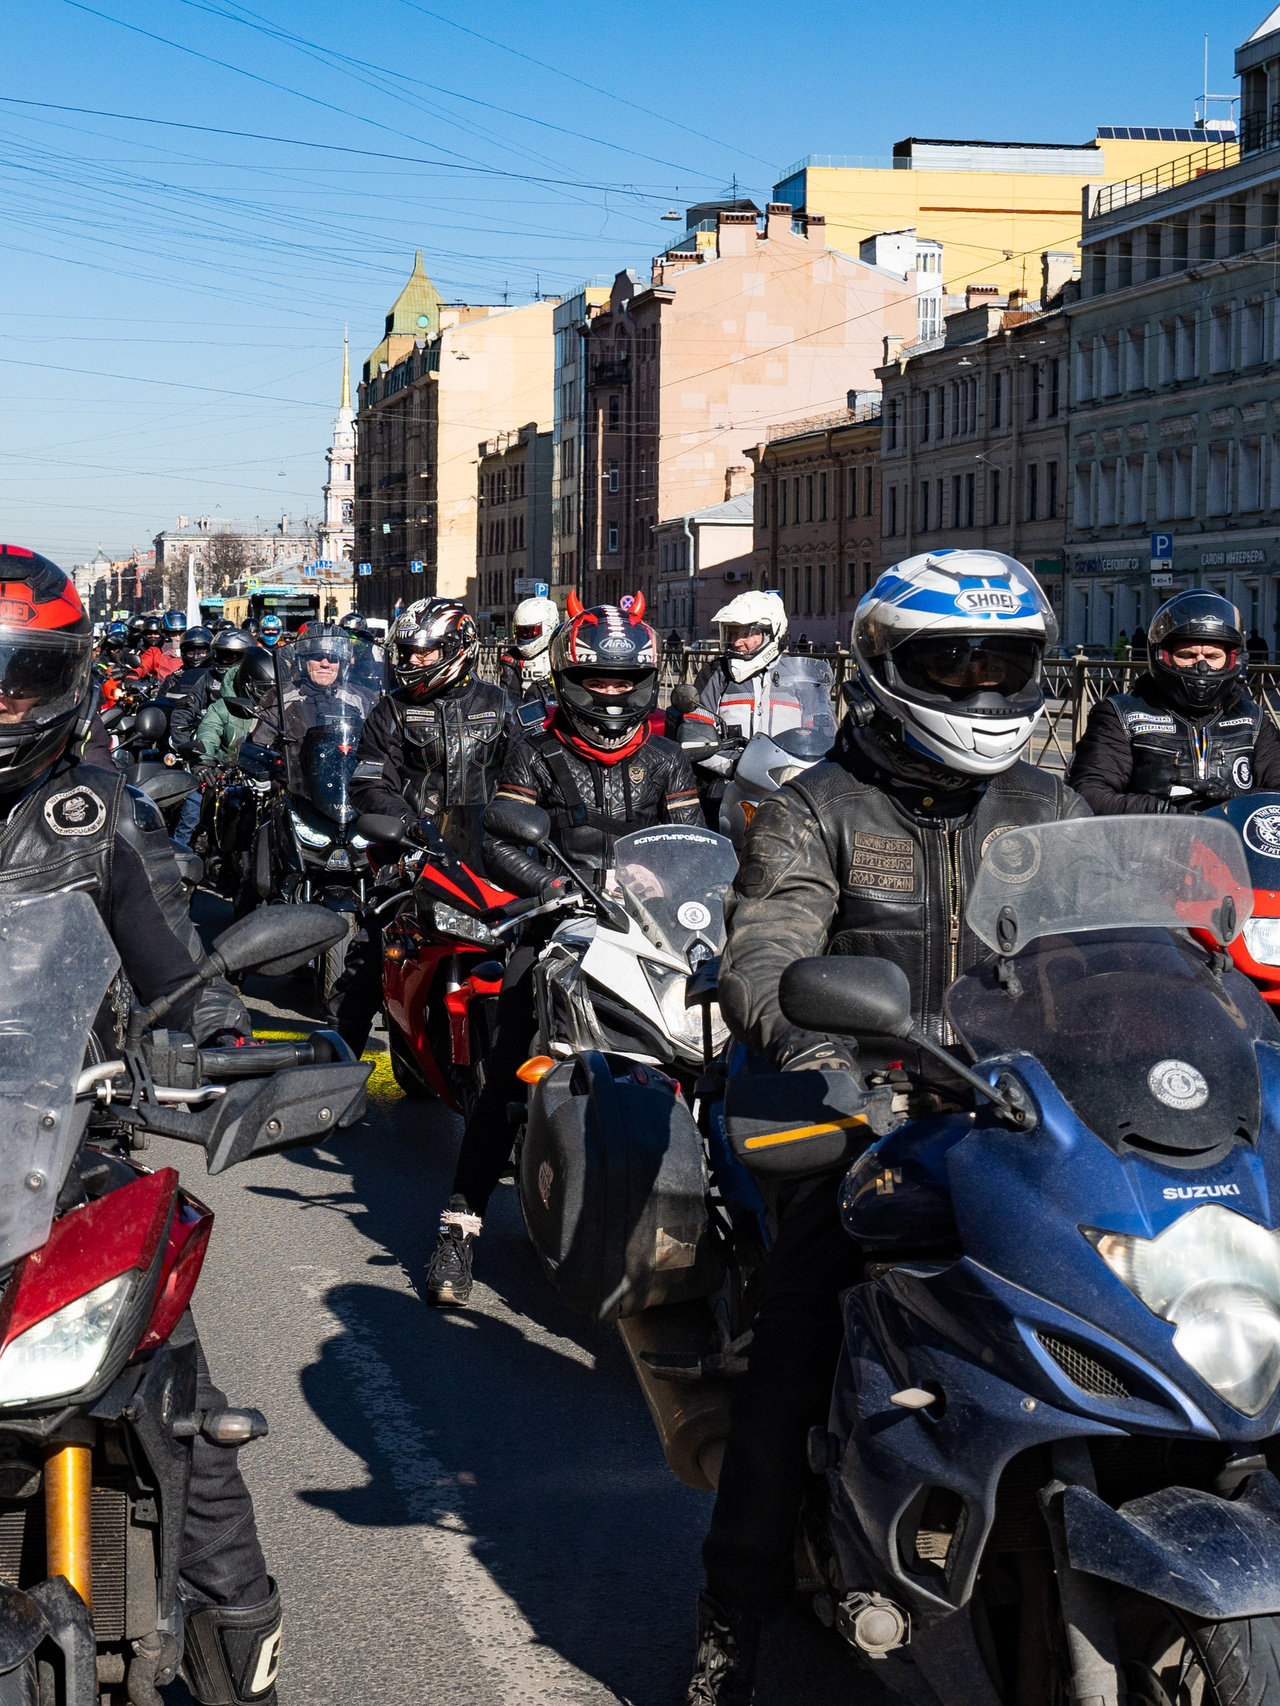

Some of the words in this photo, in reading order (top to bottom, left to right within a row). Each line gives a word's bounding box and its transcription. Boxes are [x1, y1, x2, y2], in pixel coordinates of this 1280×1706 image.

[1156, 536, 1169, 556] P
[539, 583, 546, 595] P
[966, 594, 1014, 609] SHOEI
[603, 639, 632, 649] Airoh
[852, 871, 875, 885] ROAD
[877, 875, 912, 889] CAPTAIN
[1162, 1183, 1241, 1200] SUZUKI
